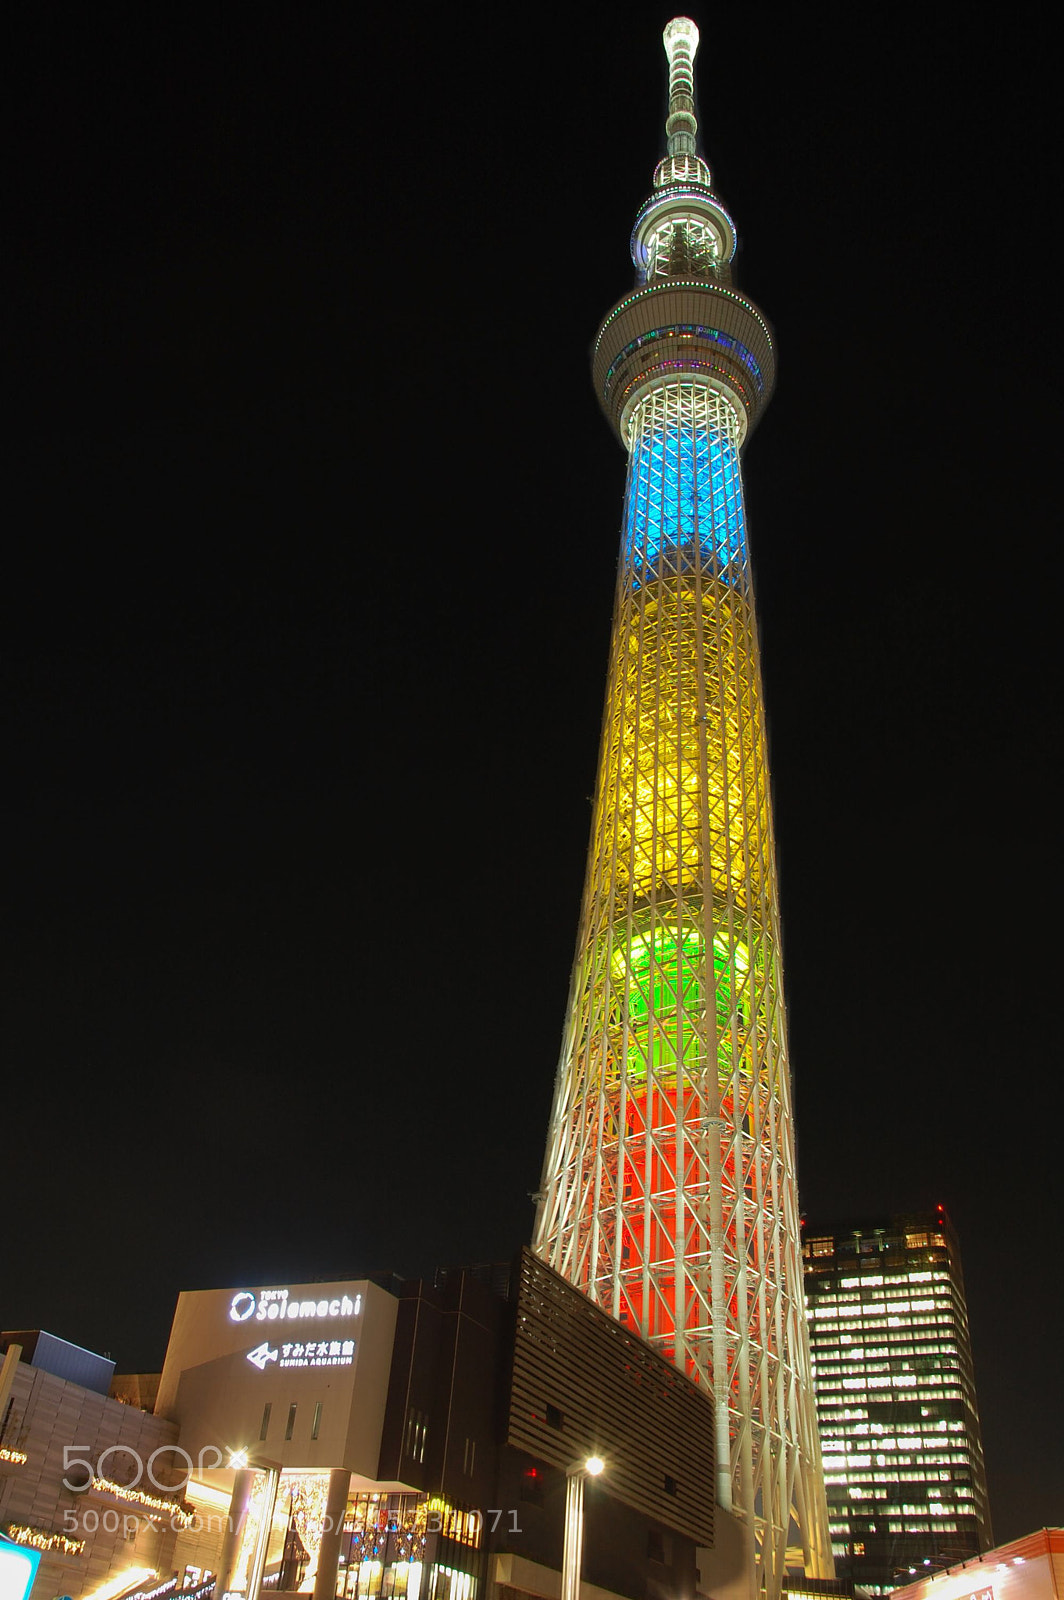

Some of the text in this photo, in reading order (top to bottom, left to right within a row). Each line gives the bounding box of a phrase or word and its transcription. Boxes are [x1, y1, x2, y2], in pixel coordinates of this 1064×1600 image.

[260, 1289, 289, 1300] TOKYO
[256, 1294, 361, 1320] Solamachi
[282, 1341, 355, 1357] すみだ水族館
[279, 1357, 353, 1368] SUMIDA AQUARIUM
